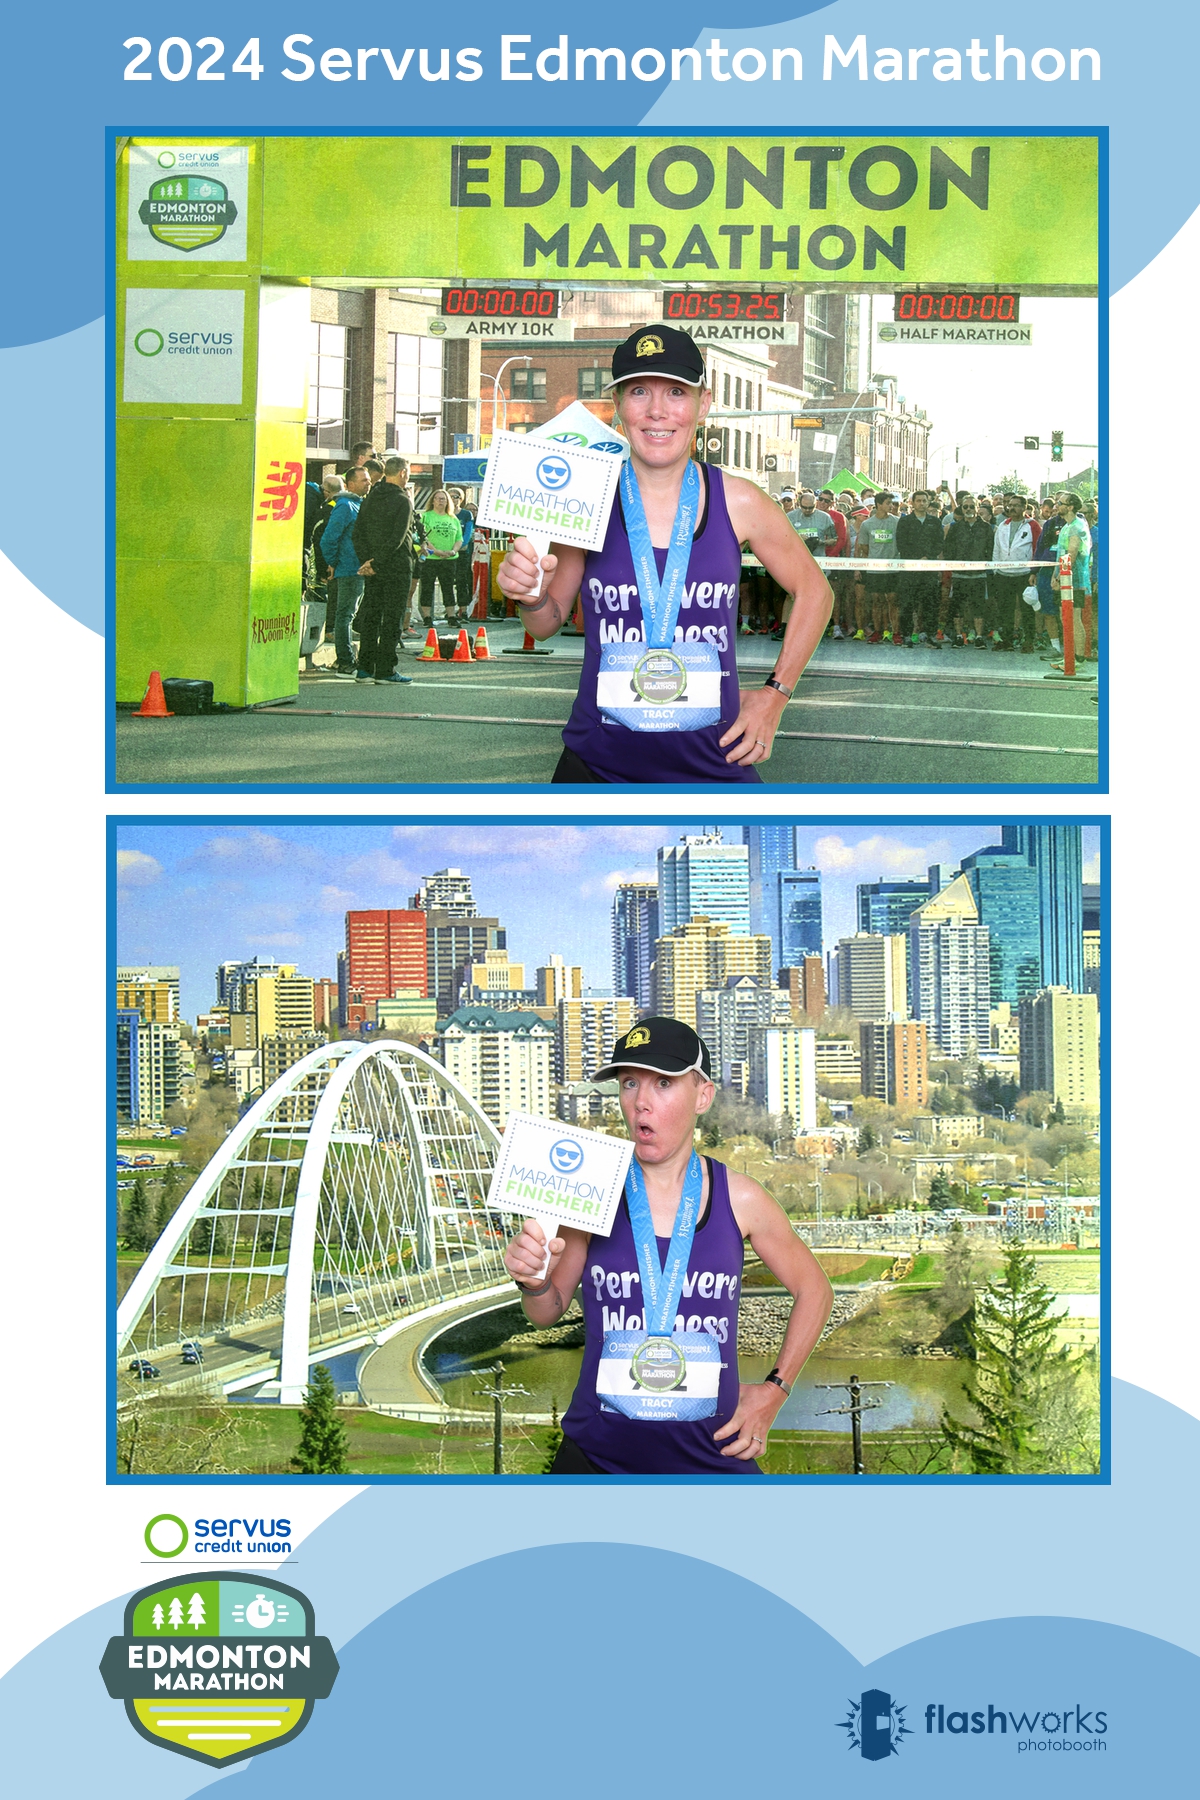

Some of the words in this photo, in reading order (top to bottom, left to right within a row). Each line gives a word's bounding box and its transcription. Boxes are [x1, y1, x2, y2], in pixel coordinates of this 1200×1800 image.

[178, 152, 219, 161] servus
[450, 144, 991, 211] EDMONTON
[149, 202, 227, 214] EDMONTON
[160, 214, 215, 222] MARATHON
[522, 222, 907, 271] MARATHON
[168, 331, 233, 345] servus
[465, 321, 518, 336] ARMY
[521, 322, 555, 337] 10K
[900, 327, 939, 341] HALF
[943, 328, 1031, 342] MARATHON
[168, 345, 200, 355] credit
[202, 346, 233, 356] union
[497, 484, 595, 518] MARATHON
[494, 499, 591, 533] FINISHER!
[641, 556, 652, 589] FINISHER
[588, 577, 737, 614] Pervere
[660, 602, 673, 643] MARATHON
[668, 568, 680, 602] FINISHER
[257, 612, 291, 638] Running
[642, 709, 675, 719] TRACY
[509, 1164, 606, 1202] MARATHON
[505, 1180, 600, 1217] FINISHER!
[643, 1243, 654, 1276] FINISHER
[590, 1265, 738, 1301] Pervere
[659, 1291, 673, 1331] MARATHON
[668, 1258, 681, 1292] FINISHER
[641, 1371, 676, 1379] MARATHON
[636, 1410, 678, 1419] MARATHON
[640, 1398, 674, 1408] TRACY
